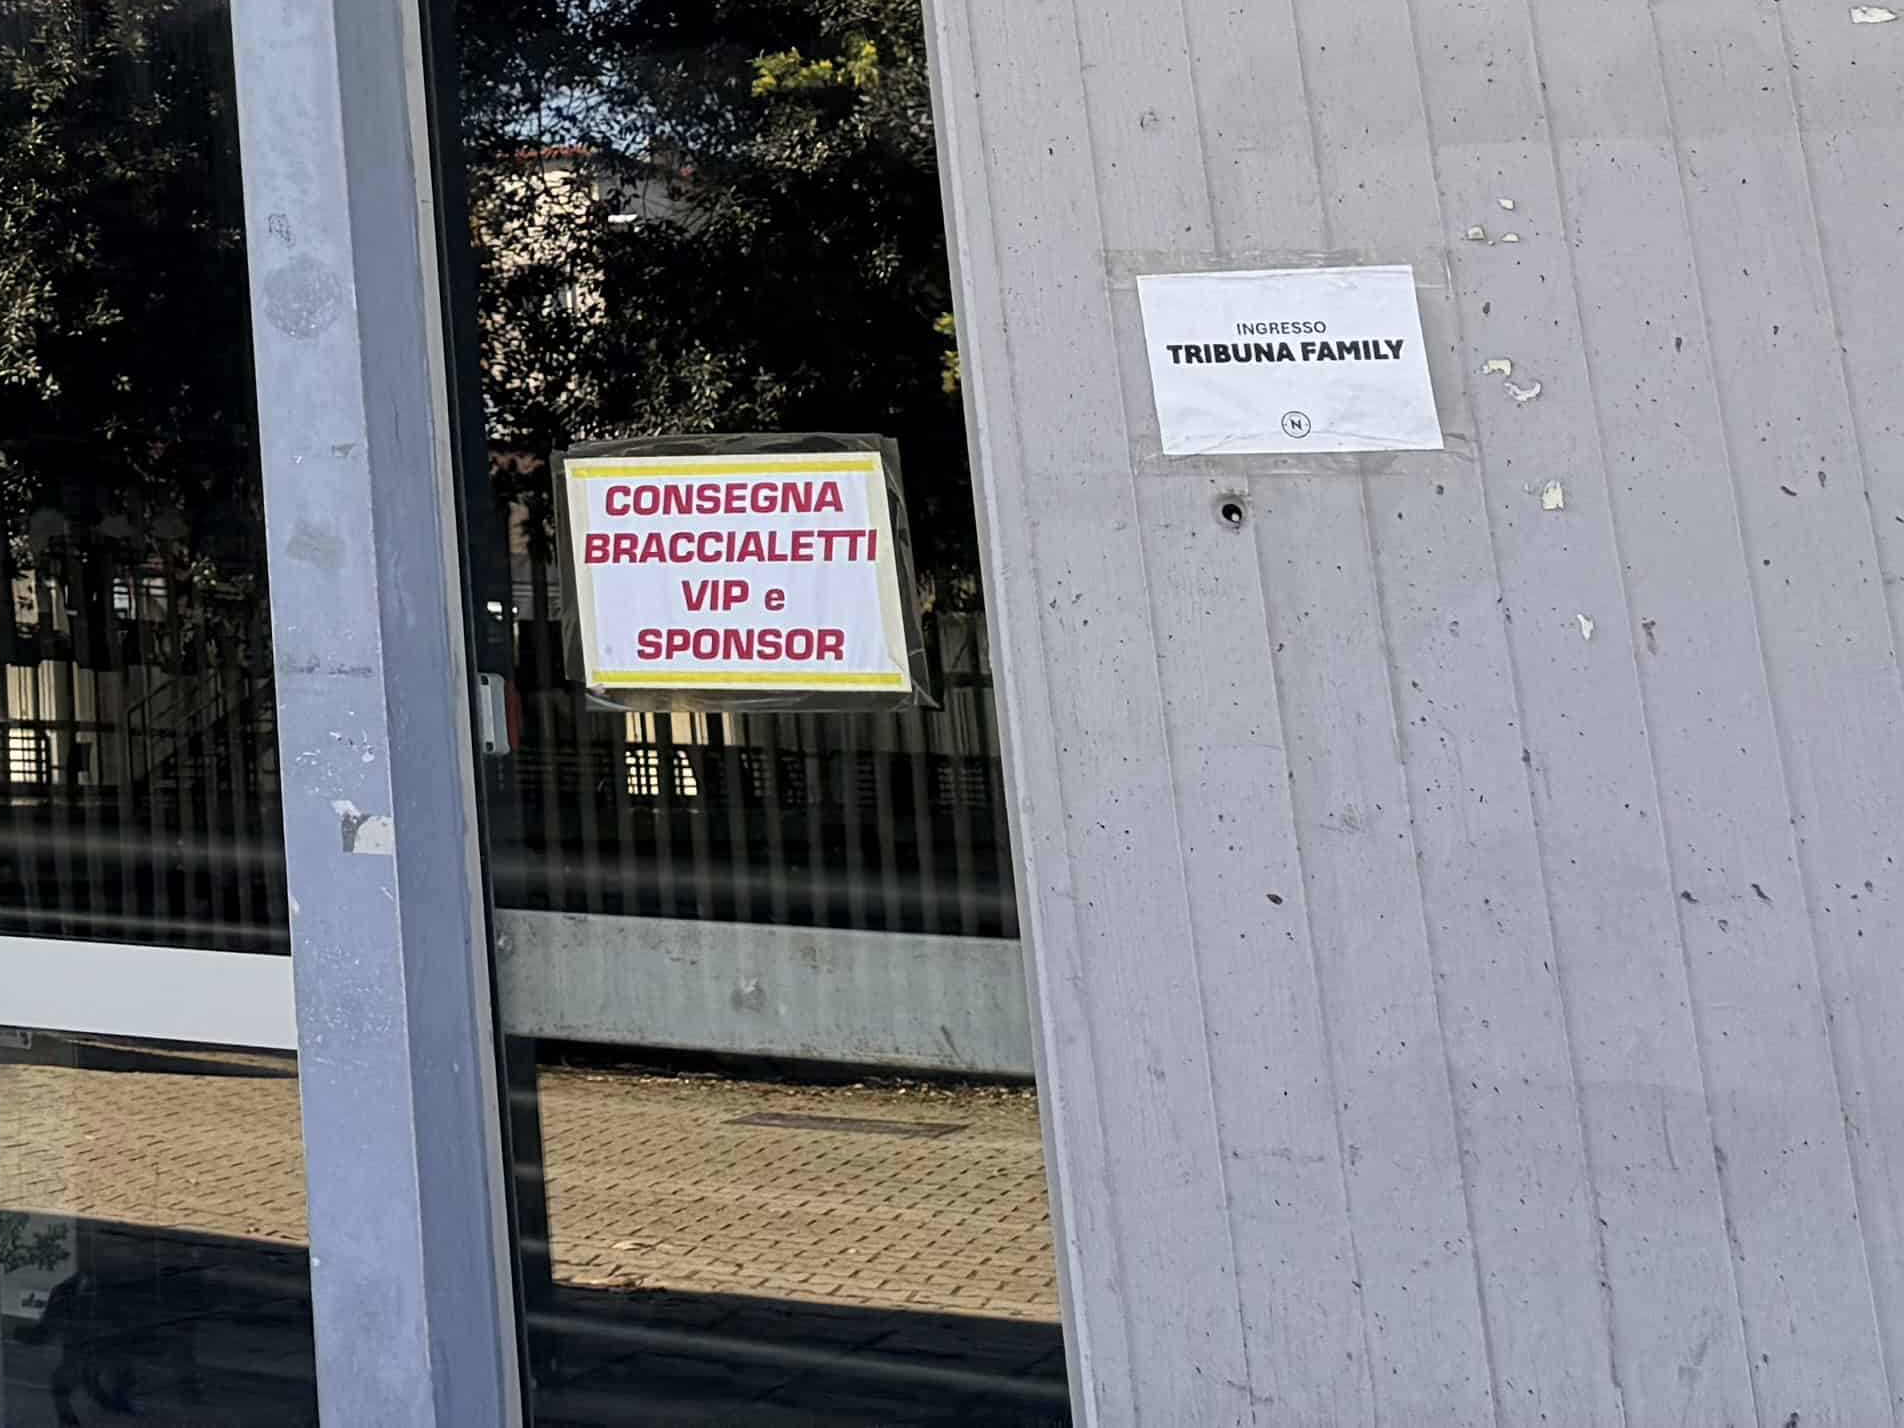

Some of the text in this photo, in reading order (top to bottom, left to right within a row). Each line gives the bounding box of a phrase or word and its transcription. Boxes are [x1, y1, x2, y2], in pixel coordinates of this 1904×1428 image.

[1237, 321, 1326, 335] INGRESSO
[1167, 340, 1403, 364] TRIBUNA FAMILY
[605, 481, 844, 516] CONSEGNA
[584, 529, 878, 564] BRACCIALETTI
[681, 579, 785, 611] VIP e
[637, 628, 845, 660] SPONSOR
